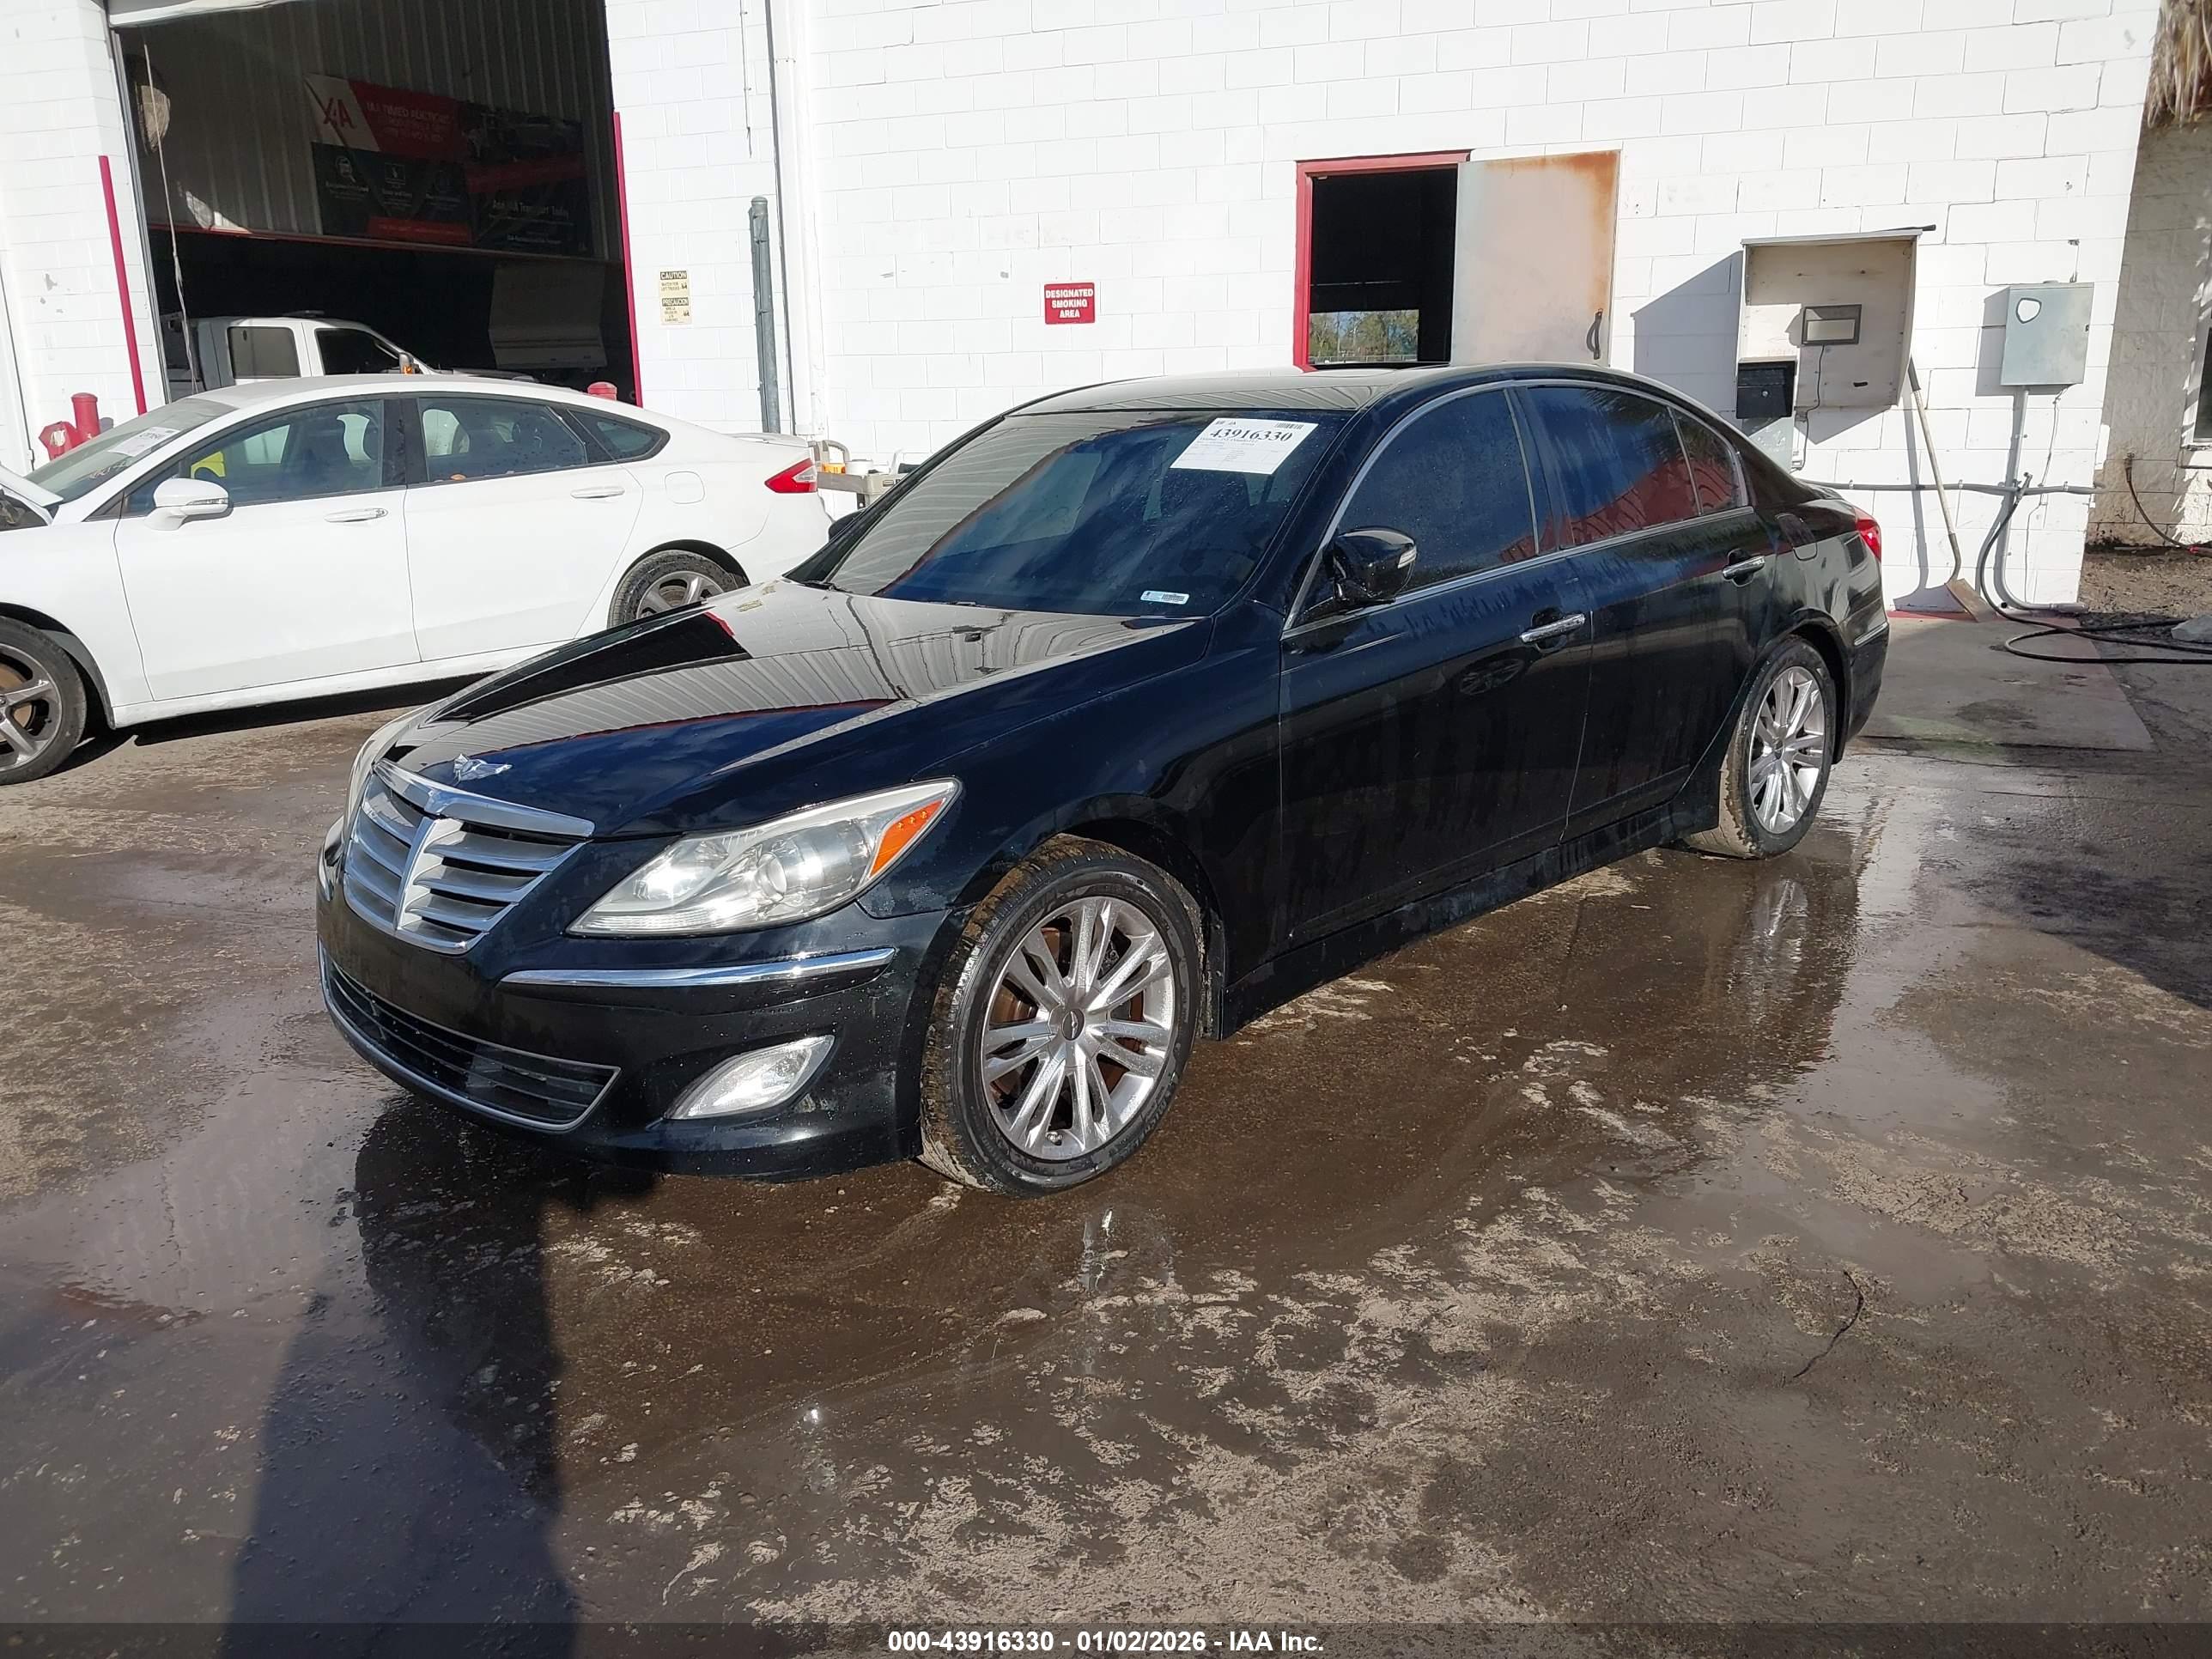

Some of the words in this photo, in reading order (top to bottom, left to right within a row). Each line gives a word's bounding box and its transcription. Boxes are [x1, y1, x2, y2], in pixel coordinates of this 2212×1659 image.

[1045, 289, 1094, 298] DESIGNATED
[1051, 298, 1088, 308] SMOKING
[1059, 309, 1080, 318] AREA
[1209, 428, 1292, 442] 43916330
